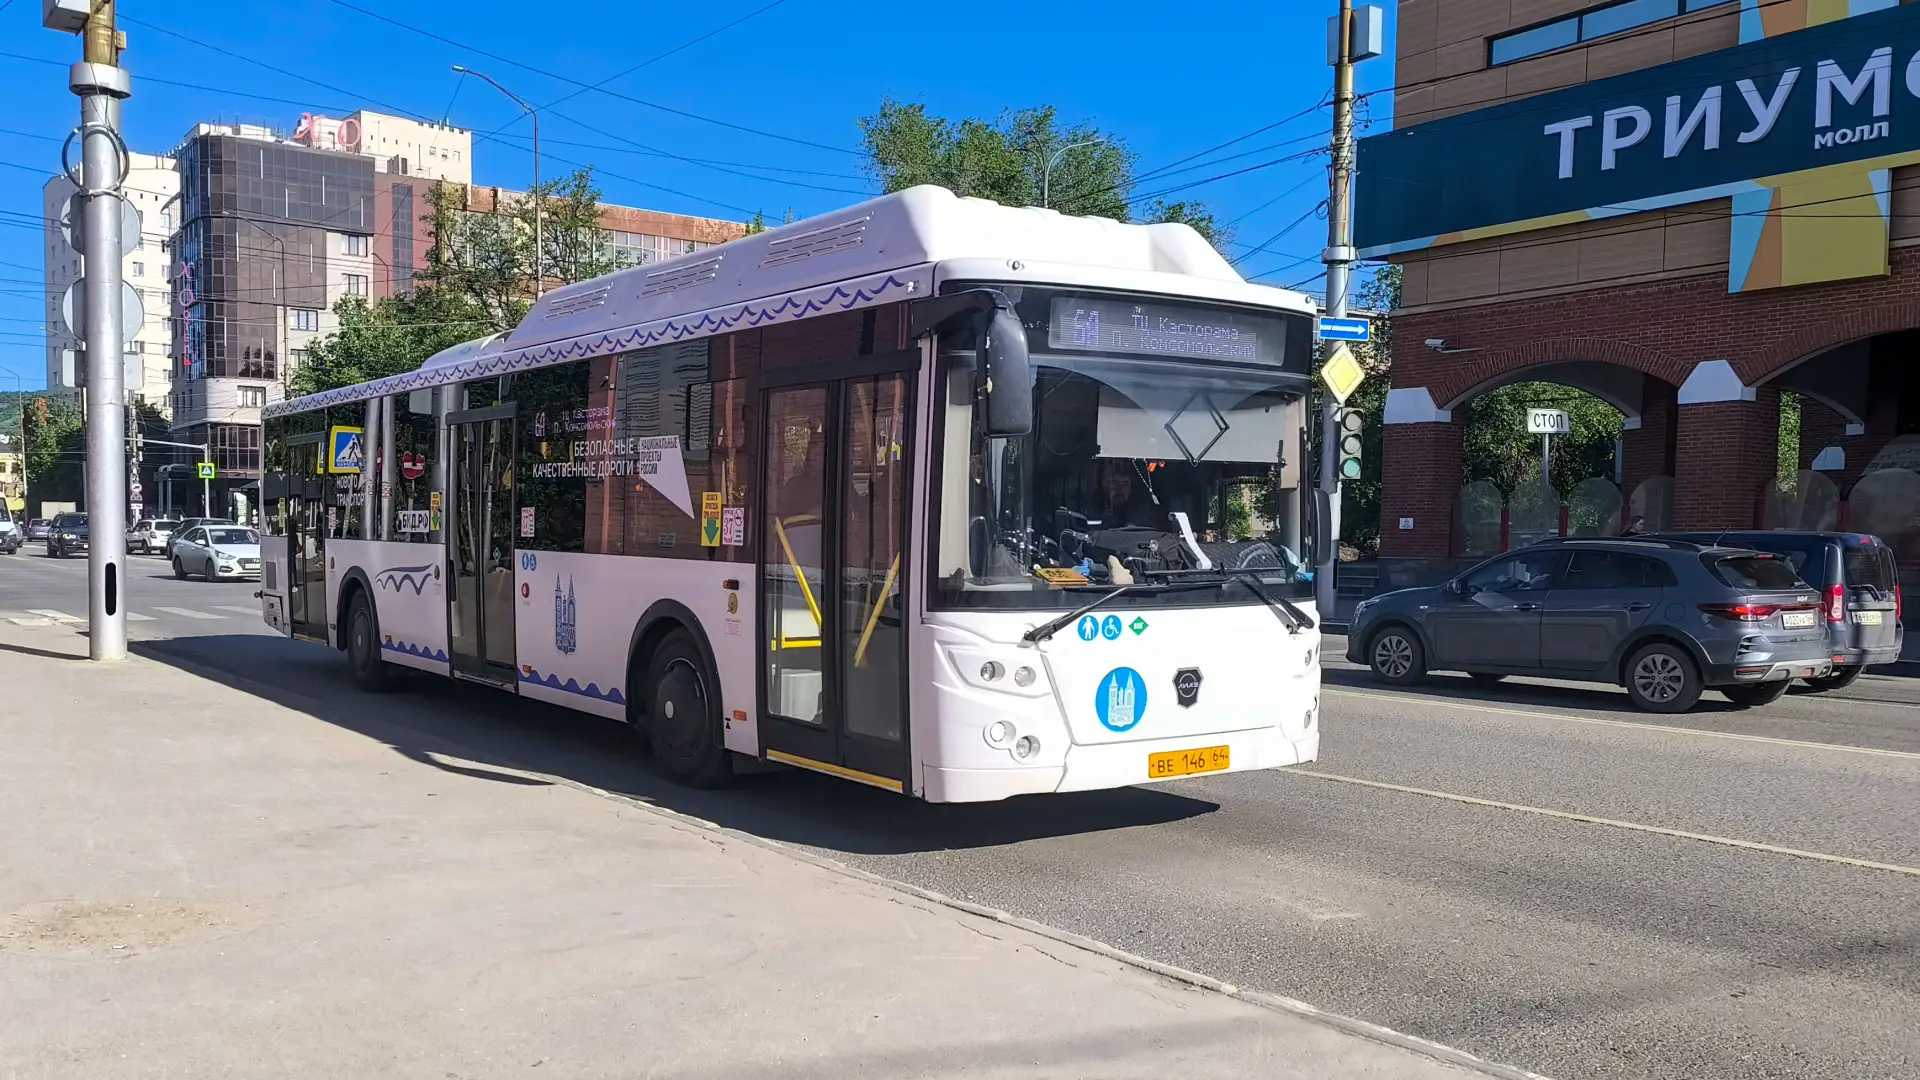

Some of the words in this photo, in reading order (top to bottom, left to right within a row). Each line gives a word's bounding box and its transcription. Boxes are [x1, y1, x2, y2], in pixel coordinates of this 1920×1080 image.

[1544, 46, 1920, 180] ТРИУМ
[1814, 121, 1889, 149] МОЛЛ
[1159, 316, 1239, 340] Касторама
[1533, 413, 1563, 428] СТОП
[574, 438, 634, 457] БЕЗОПАСНЫЕ
[640, 450, 662, 463] ПРОЕКТЫ
[532, 462, 596, 479] КАЧЕСТВЕННЫЕ
[597, 460, 634, 479] ДОРОГИ
[402, 512, 429, 531] БКД.РФ
[1157, 758, 1175, 774] ВЕ
[1182, 753, 1206, 771] 146
[1212, 748, 1225, 763] 64
